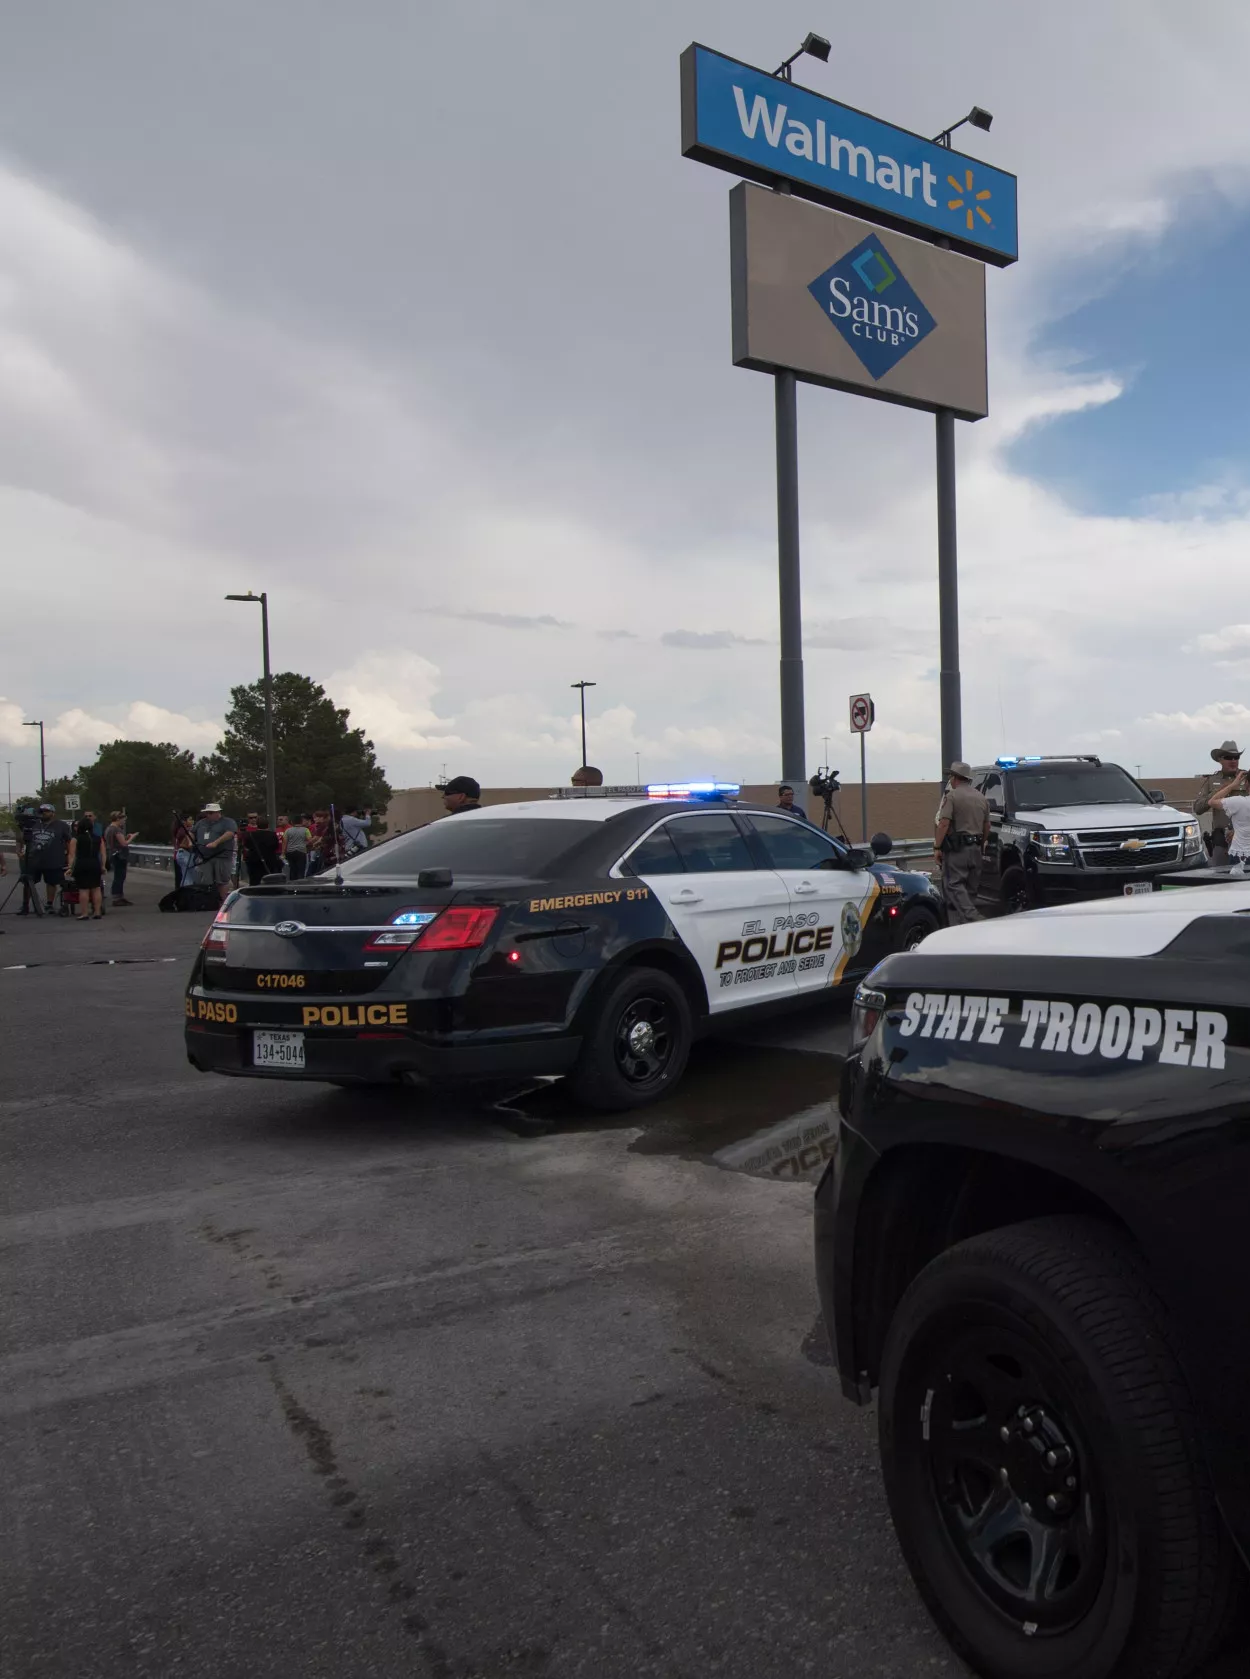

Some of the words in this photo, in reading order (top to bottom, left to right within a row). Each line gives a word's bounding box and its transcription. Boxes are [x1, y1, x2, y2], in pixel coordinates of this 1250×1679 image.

[732, 84, 937, 207] Walmart
[829, 277, 919, 338] Sam's
[852, 323, 900, 346] CLUB
[67, 801, 79, 809] 15
[529, 891, 622, 913] EMERGENCY
[626, 888, 649, 902] 911
[741, 919, 766, 937] EL
[772, 911, 820, 932] PASO
[713, 924, 835, 969] POLICE
[256, 974, 306, 988] C17046
[720, 972, 734, 988] TO
[734, 962, 778, 985] PROTECT
[777, 959, 797, 976] AND
[798, 953, 826, 972] SERVE
[197, 1000, 238, 1024] PASO
[302, 1004, 408, 1026] POLICE
[270, 1033, 291, 1042] TEXAS
[899, 992, 1010, 1045] STATE
[1019, 999, 1229, 1070] TROOPER
